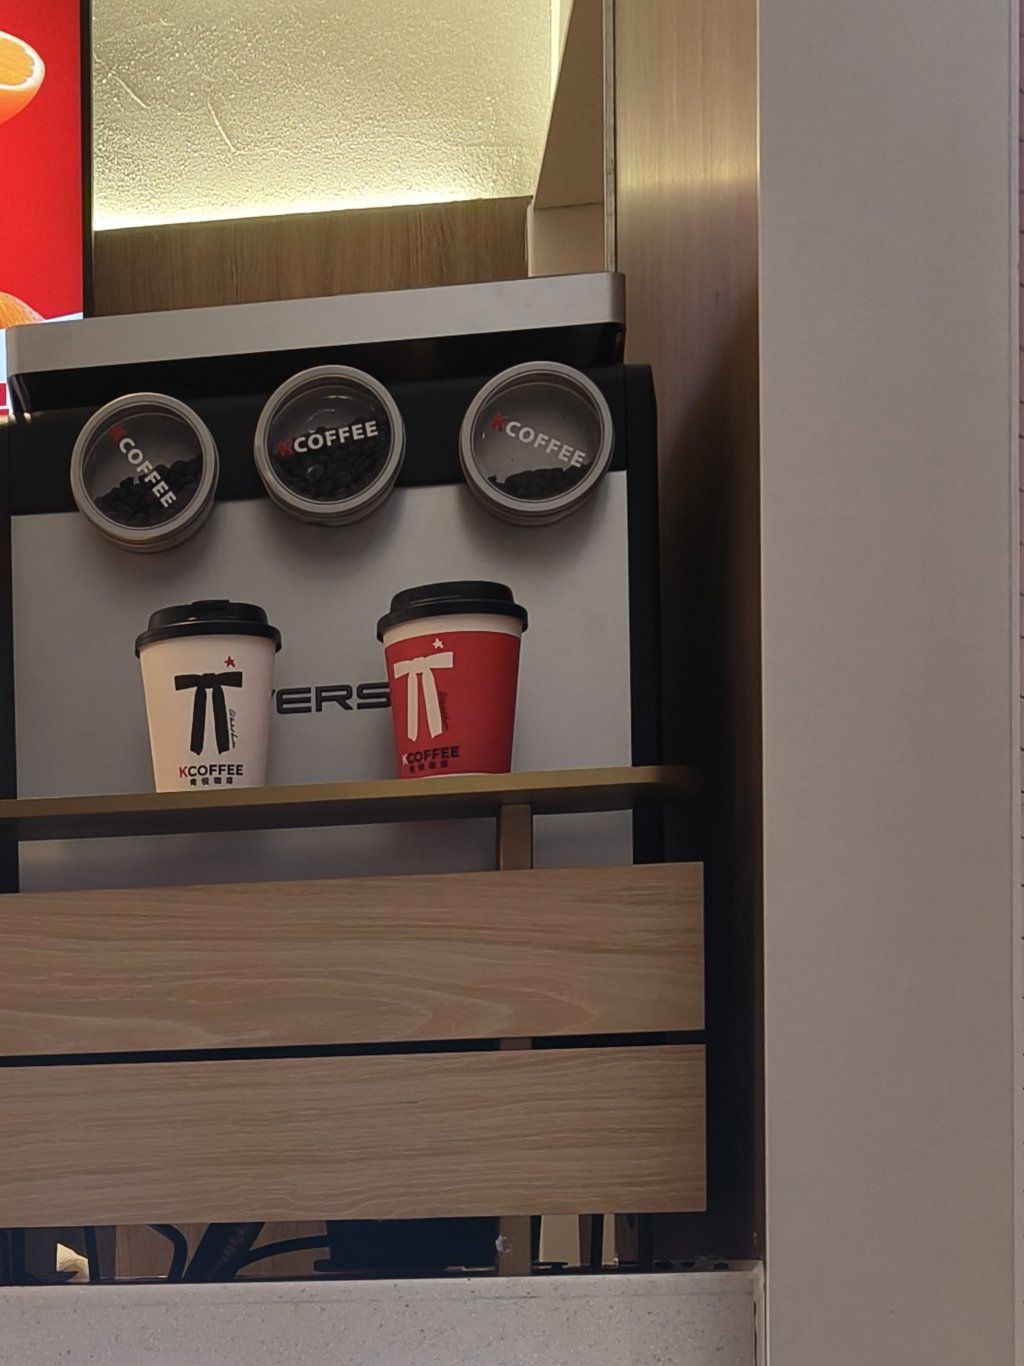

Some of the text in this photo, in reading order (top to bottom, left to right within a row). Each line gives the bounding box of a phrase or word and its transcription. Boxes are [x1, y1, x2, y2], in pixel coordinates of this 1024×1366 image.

[271, 682, 391, 715] ERS
[402, 745, 460, 766] KCOFFEE
[179, 764, 244, 779] KCOFFEE
